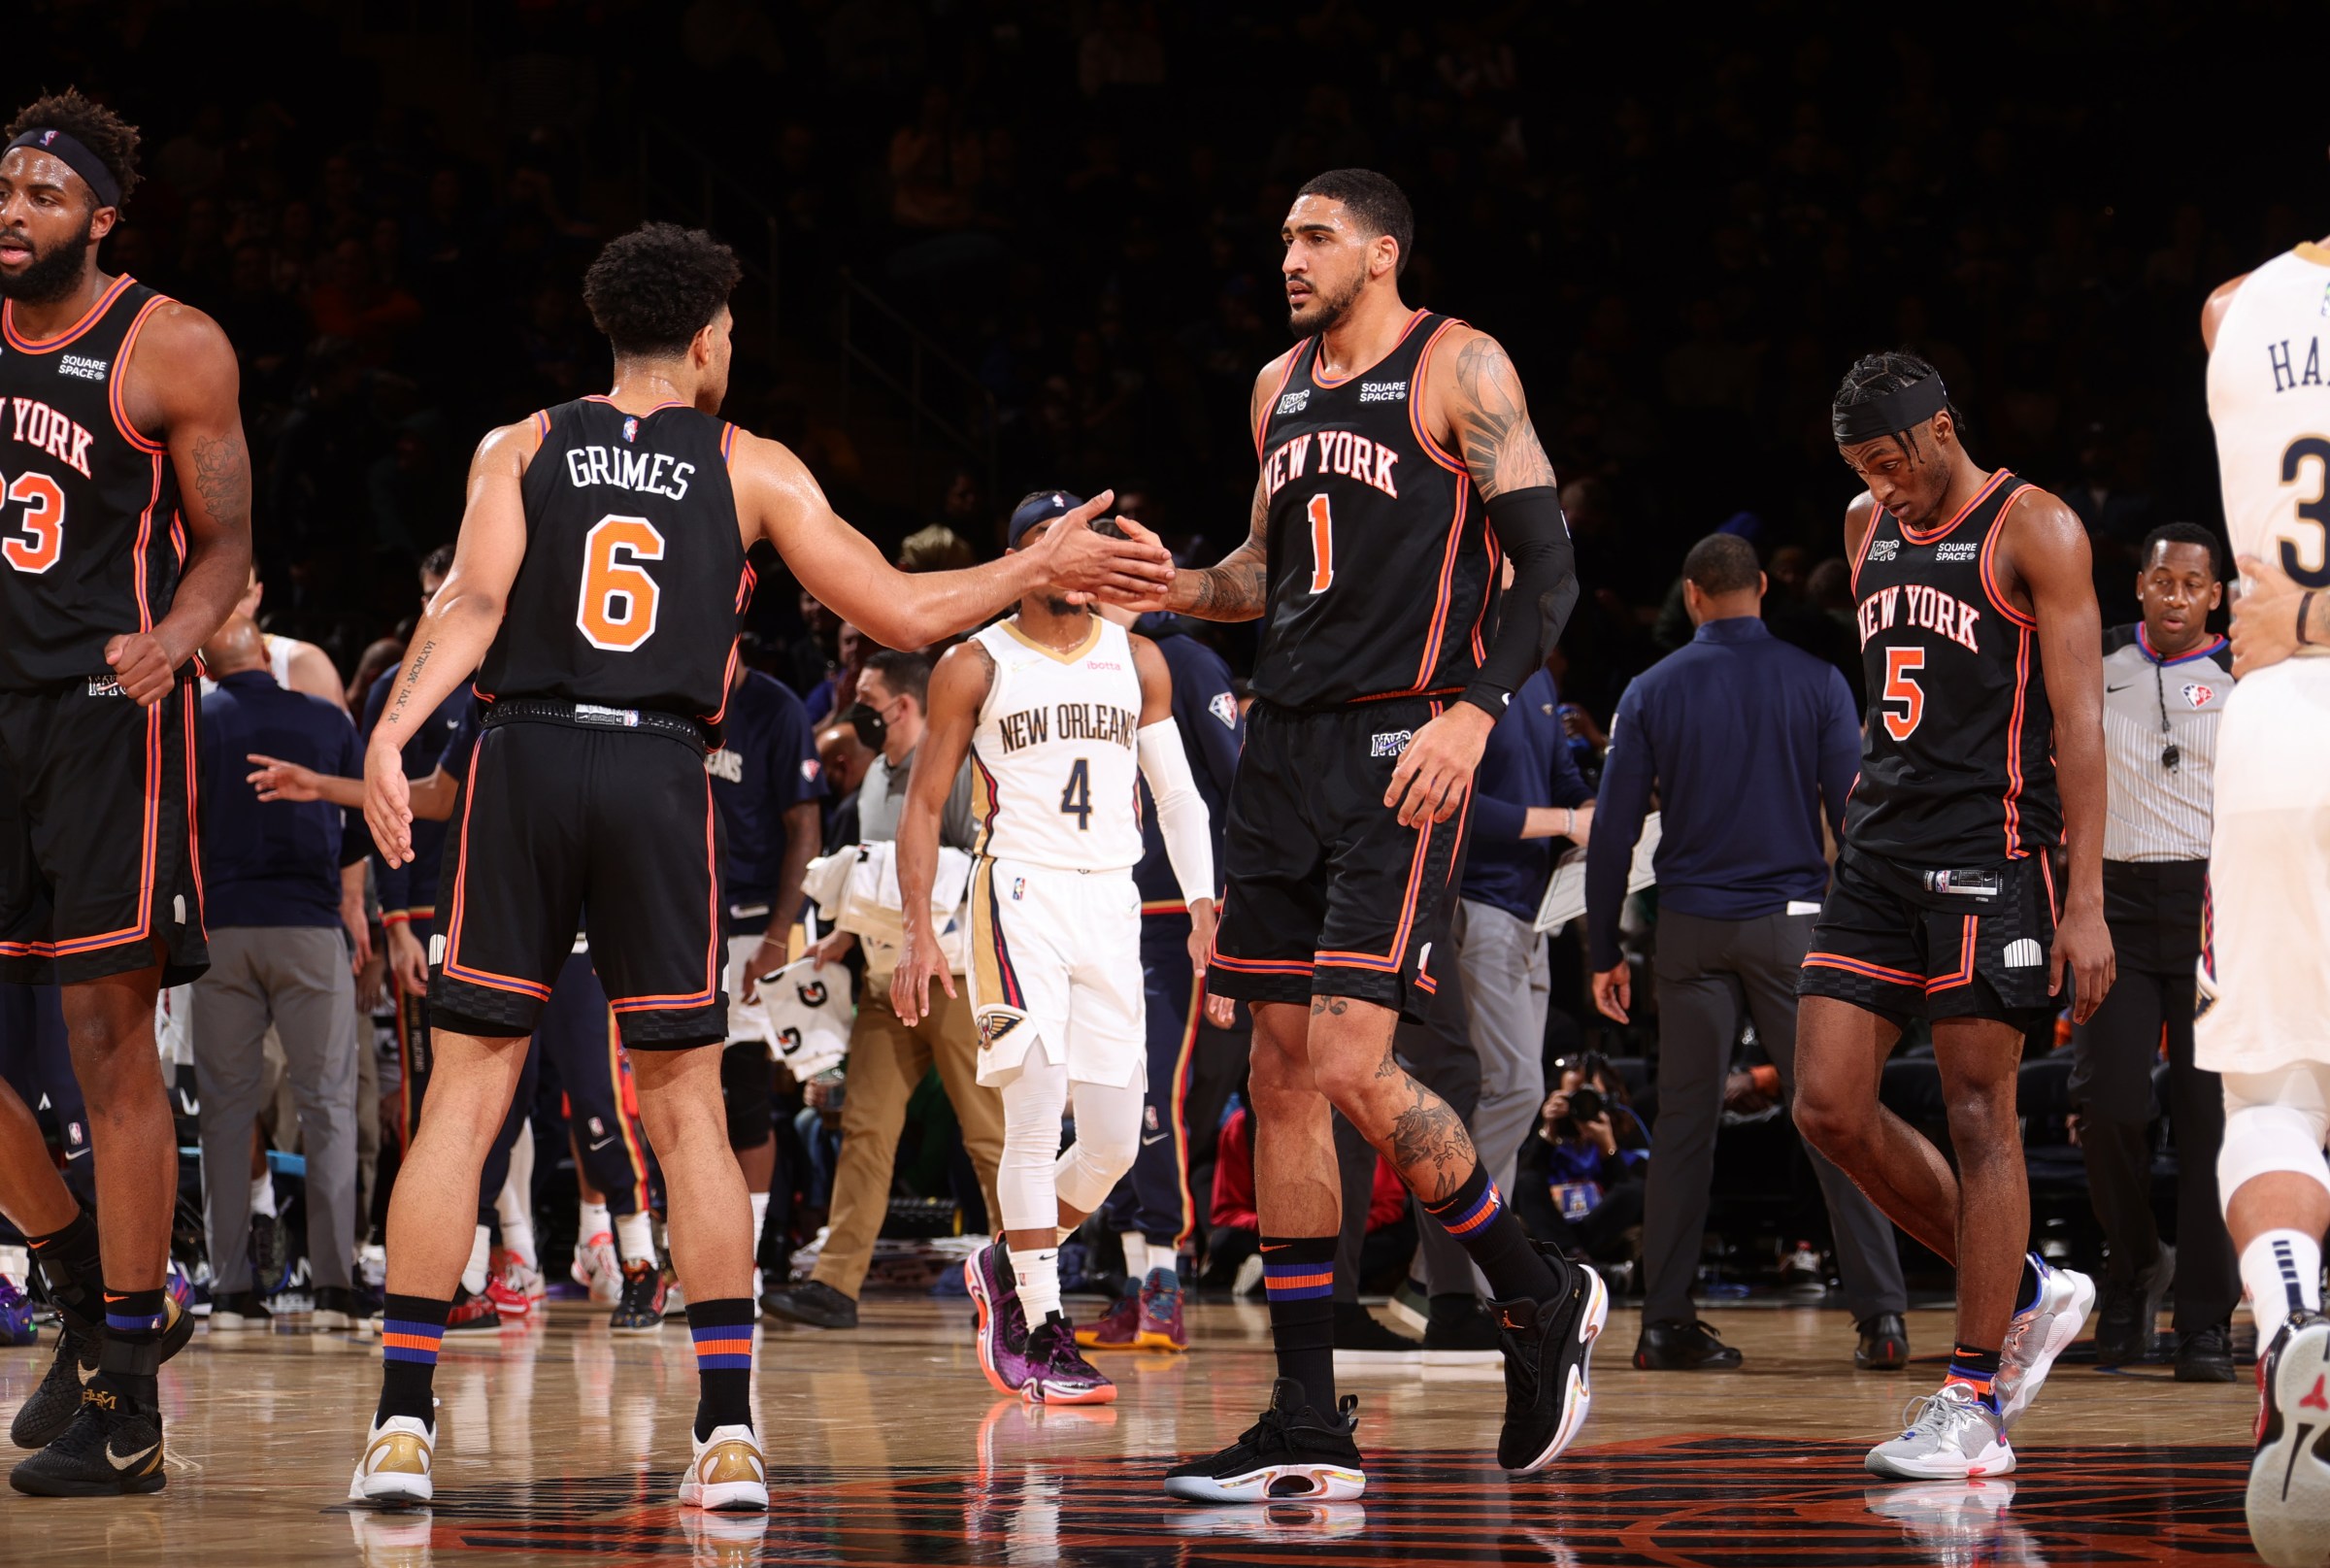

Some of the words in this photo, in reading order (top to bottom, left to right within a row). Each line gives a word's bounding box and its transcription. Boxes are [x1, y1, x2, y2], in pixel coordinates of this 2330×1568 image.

[58, 364, 94, 380] SPACE
[62, 354, 107, 371] SQUARE
[1361, 382, 1407, 392] SQUARE
[2268, 335, 2330, 393] HA
[1359, 391, 1395, 402] SPACE
[12, 397, 94, 480] YORK
[1264, 433, 1313, 504] NEW
[1317, 431, 1399, 499] YORK
[566, 446, 696, 501] GRIMES
[0, 470, 65, 574] 3
[2277, 433, 2330, 592] 3
[1307, 493, 1334, 594] 1
[1935, 551, 1967, 561] SPACE
[1938, 543, 1978, 552] SQUARE
[576, 514, 665, 652] 6
[1857, 585, 1900, 654] NEW
[1904, 584, 1980, 654] YORK
[1086, 661, 1121, 671] ibotta
[1882, 647, 1924, 741] 5
[998, 706, 1048, 755] NEW
[1056, 703, 1136, 751] ORLEANS
[1060, 757, 1094, 832] 4
